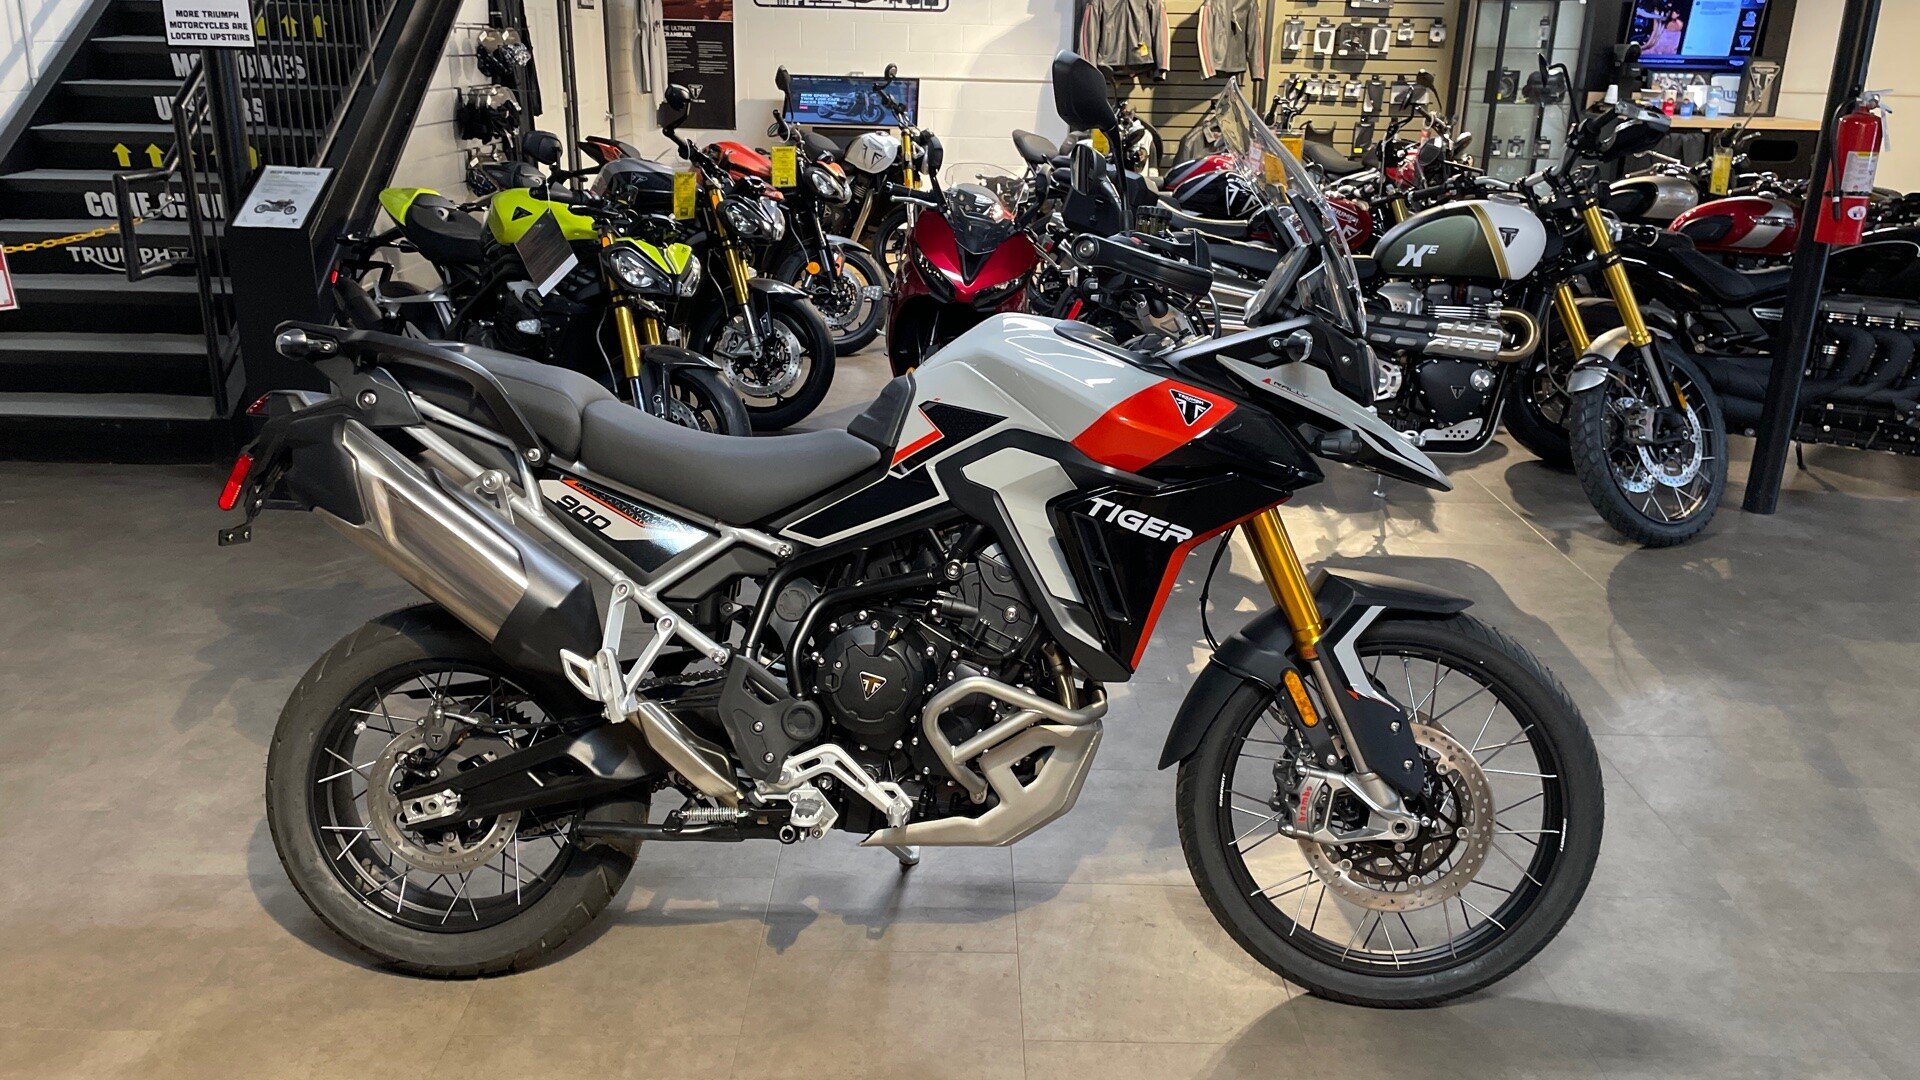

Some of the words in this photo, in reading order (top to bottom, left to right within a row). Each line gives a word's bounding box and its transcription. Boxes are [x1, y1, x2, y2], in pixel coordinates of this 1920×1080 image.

[175, 10, 199, 18] MORE
[202, 10, 239, 18] TRIUMPH
[169, 21, 229, 30] MOTORCYCLES
[232, 22, 248, 30] ARE
[170, 32, 208, 40] LOCATED
[210, 33, 250, 41] UPSTAIRS
[1273, 381, 1309, 398] RALLY
[1177, 392, 1204, 406] TRIUMPH
[560, 494, 612, 530] 900
[1087, 497, 1194, 544] TIGER
[1297, 785, 1313, 823] brembo
